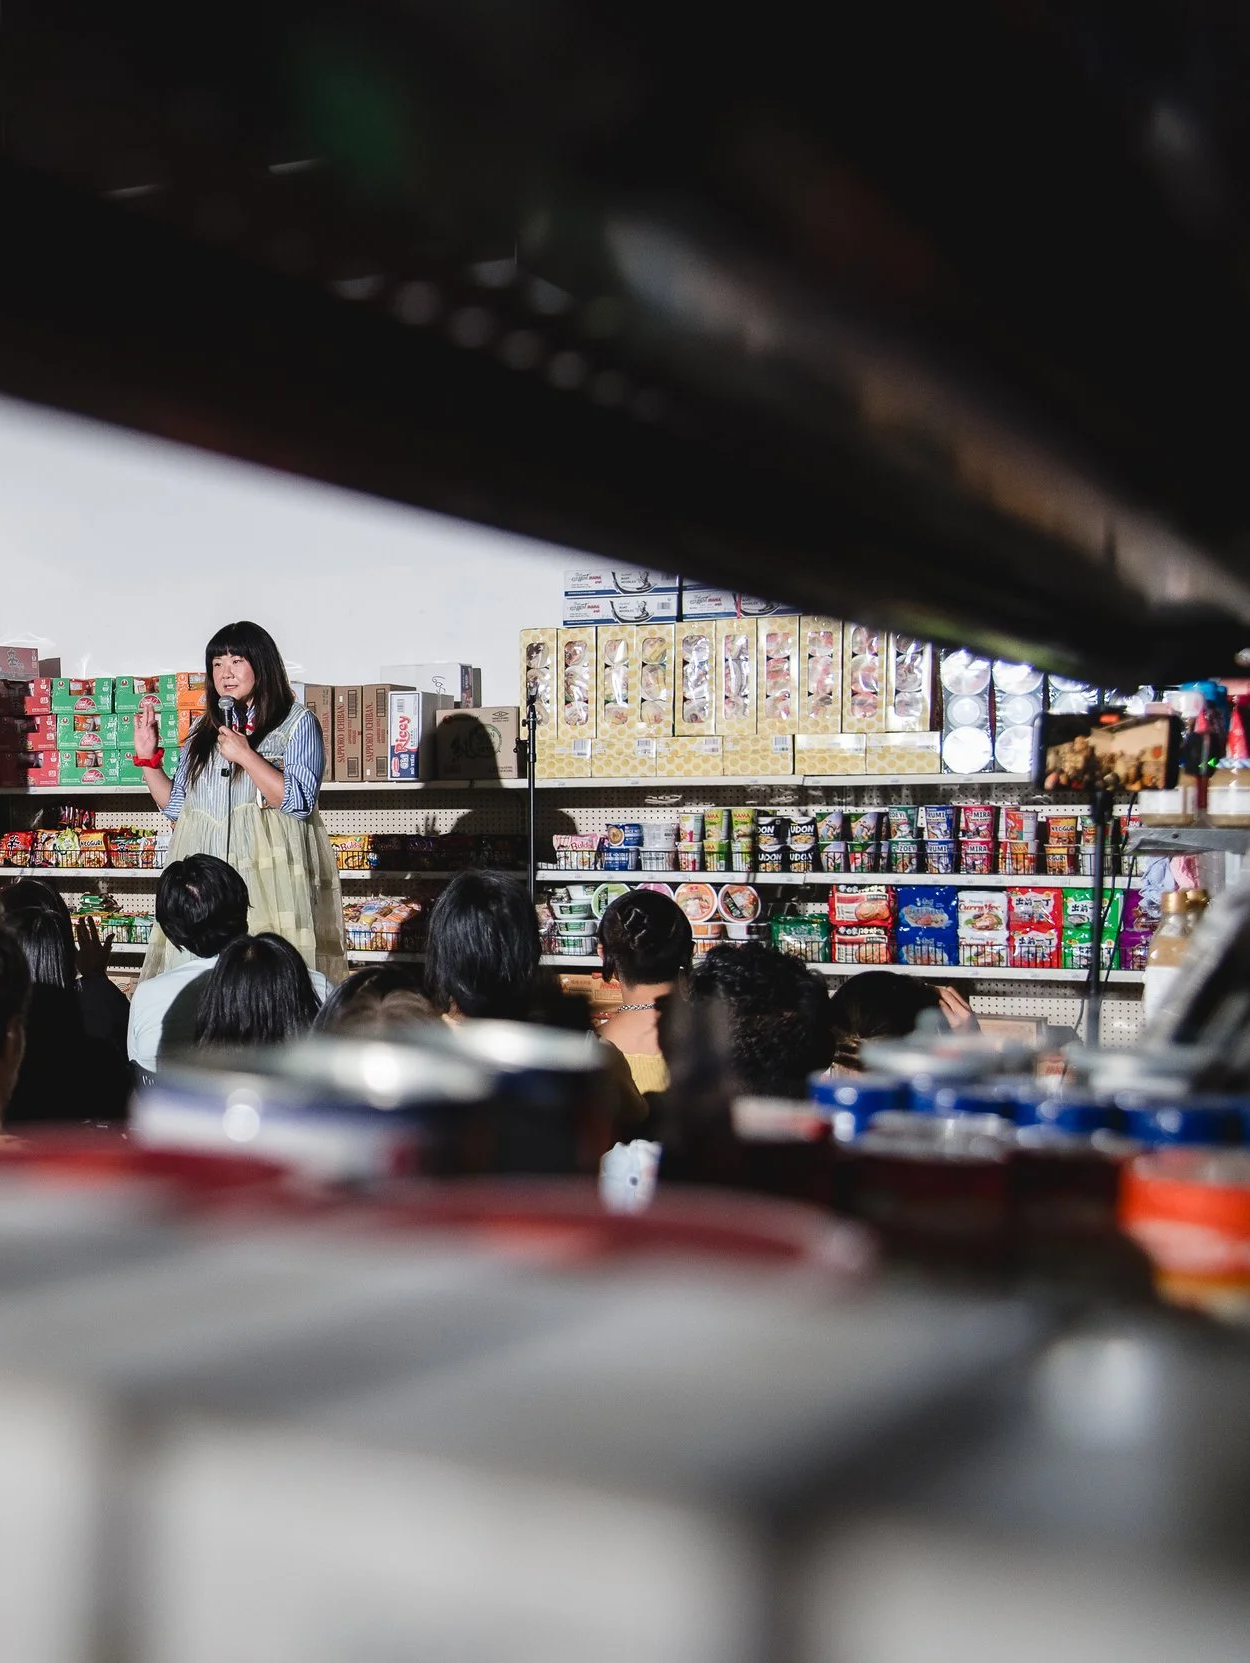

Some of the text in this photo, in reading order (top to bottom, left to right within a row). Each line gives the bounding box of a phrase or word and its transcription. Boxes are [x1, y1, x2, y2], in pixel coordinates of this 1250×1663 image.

[337, 705, 345, 763] SAPPORO ICHIBAN
[366, 705, 374, 763] SAPPORO ICHIBAN
[395, 716, 411, 753] Ricey
[791, 824, 814, 834] UDON
[758, 852, 782, 862] UDON
[1015, 898, 1051, 906] 出前一丁
[1071, 904, 1094, 913] 出前一
[1018, 937, 1054, 946] 出前一丁
